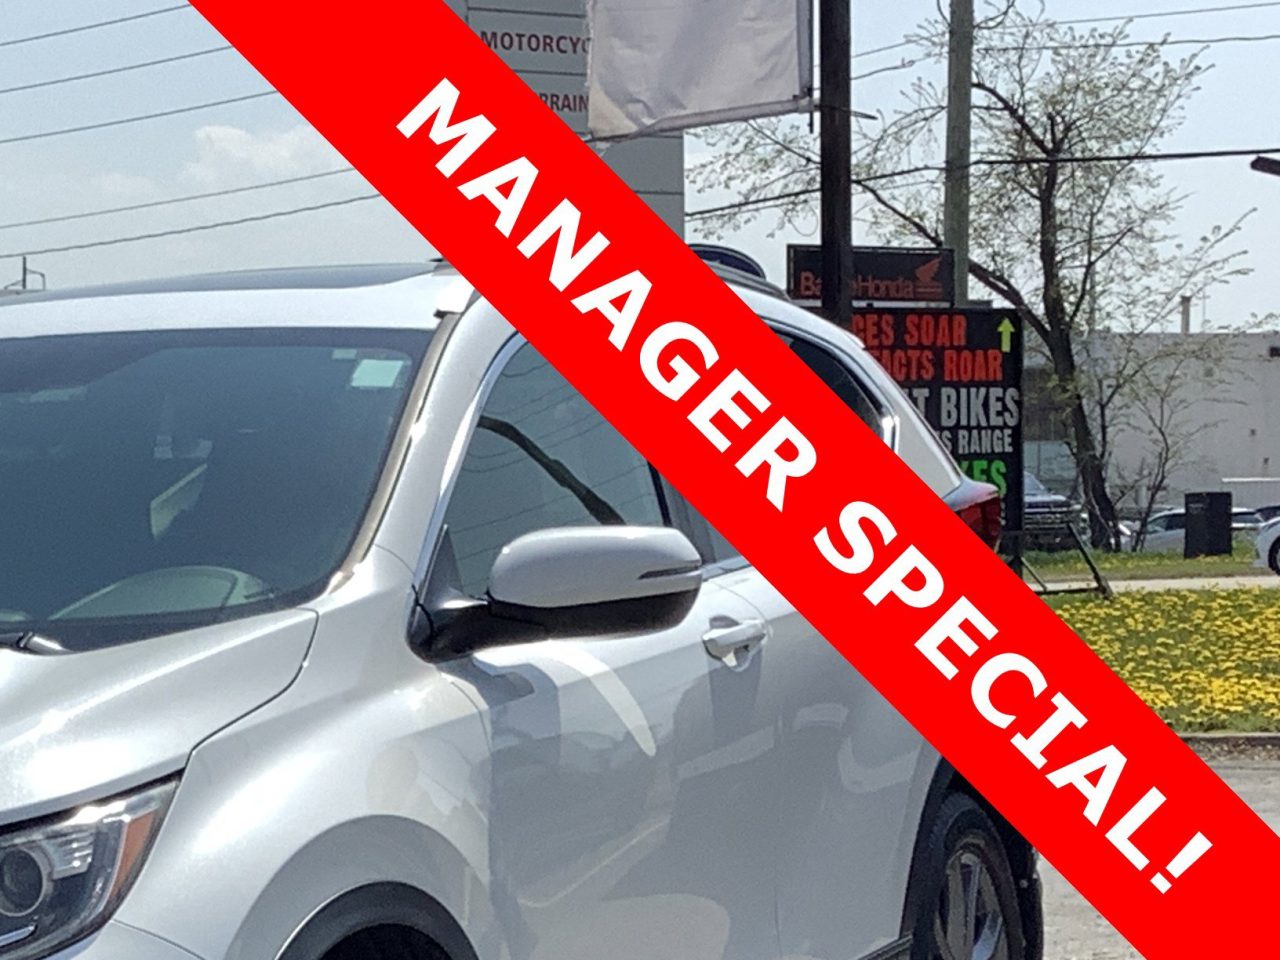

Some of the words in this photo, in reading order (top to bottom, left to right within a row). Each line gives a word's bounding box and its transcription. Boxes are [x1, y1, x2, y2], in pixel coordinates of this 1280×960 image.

[905, 314, 967, 346] SOAR
[871, 350, 935, 381] ACTS
[943, 349, 1003, 382] ROAR
[940, 387, 1020, 428] BIKES
[958, 429, 1013, 454] RANGE
